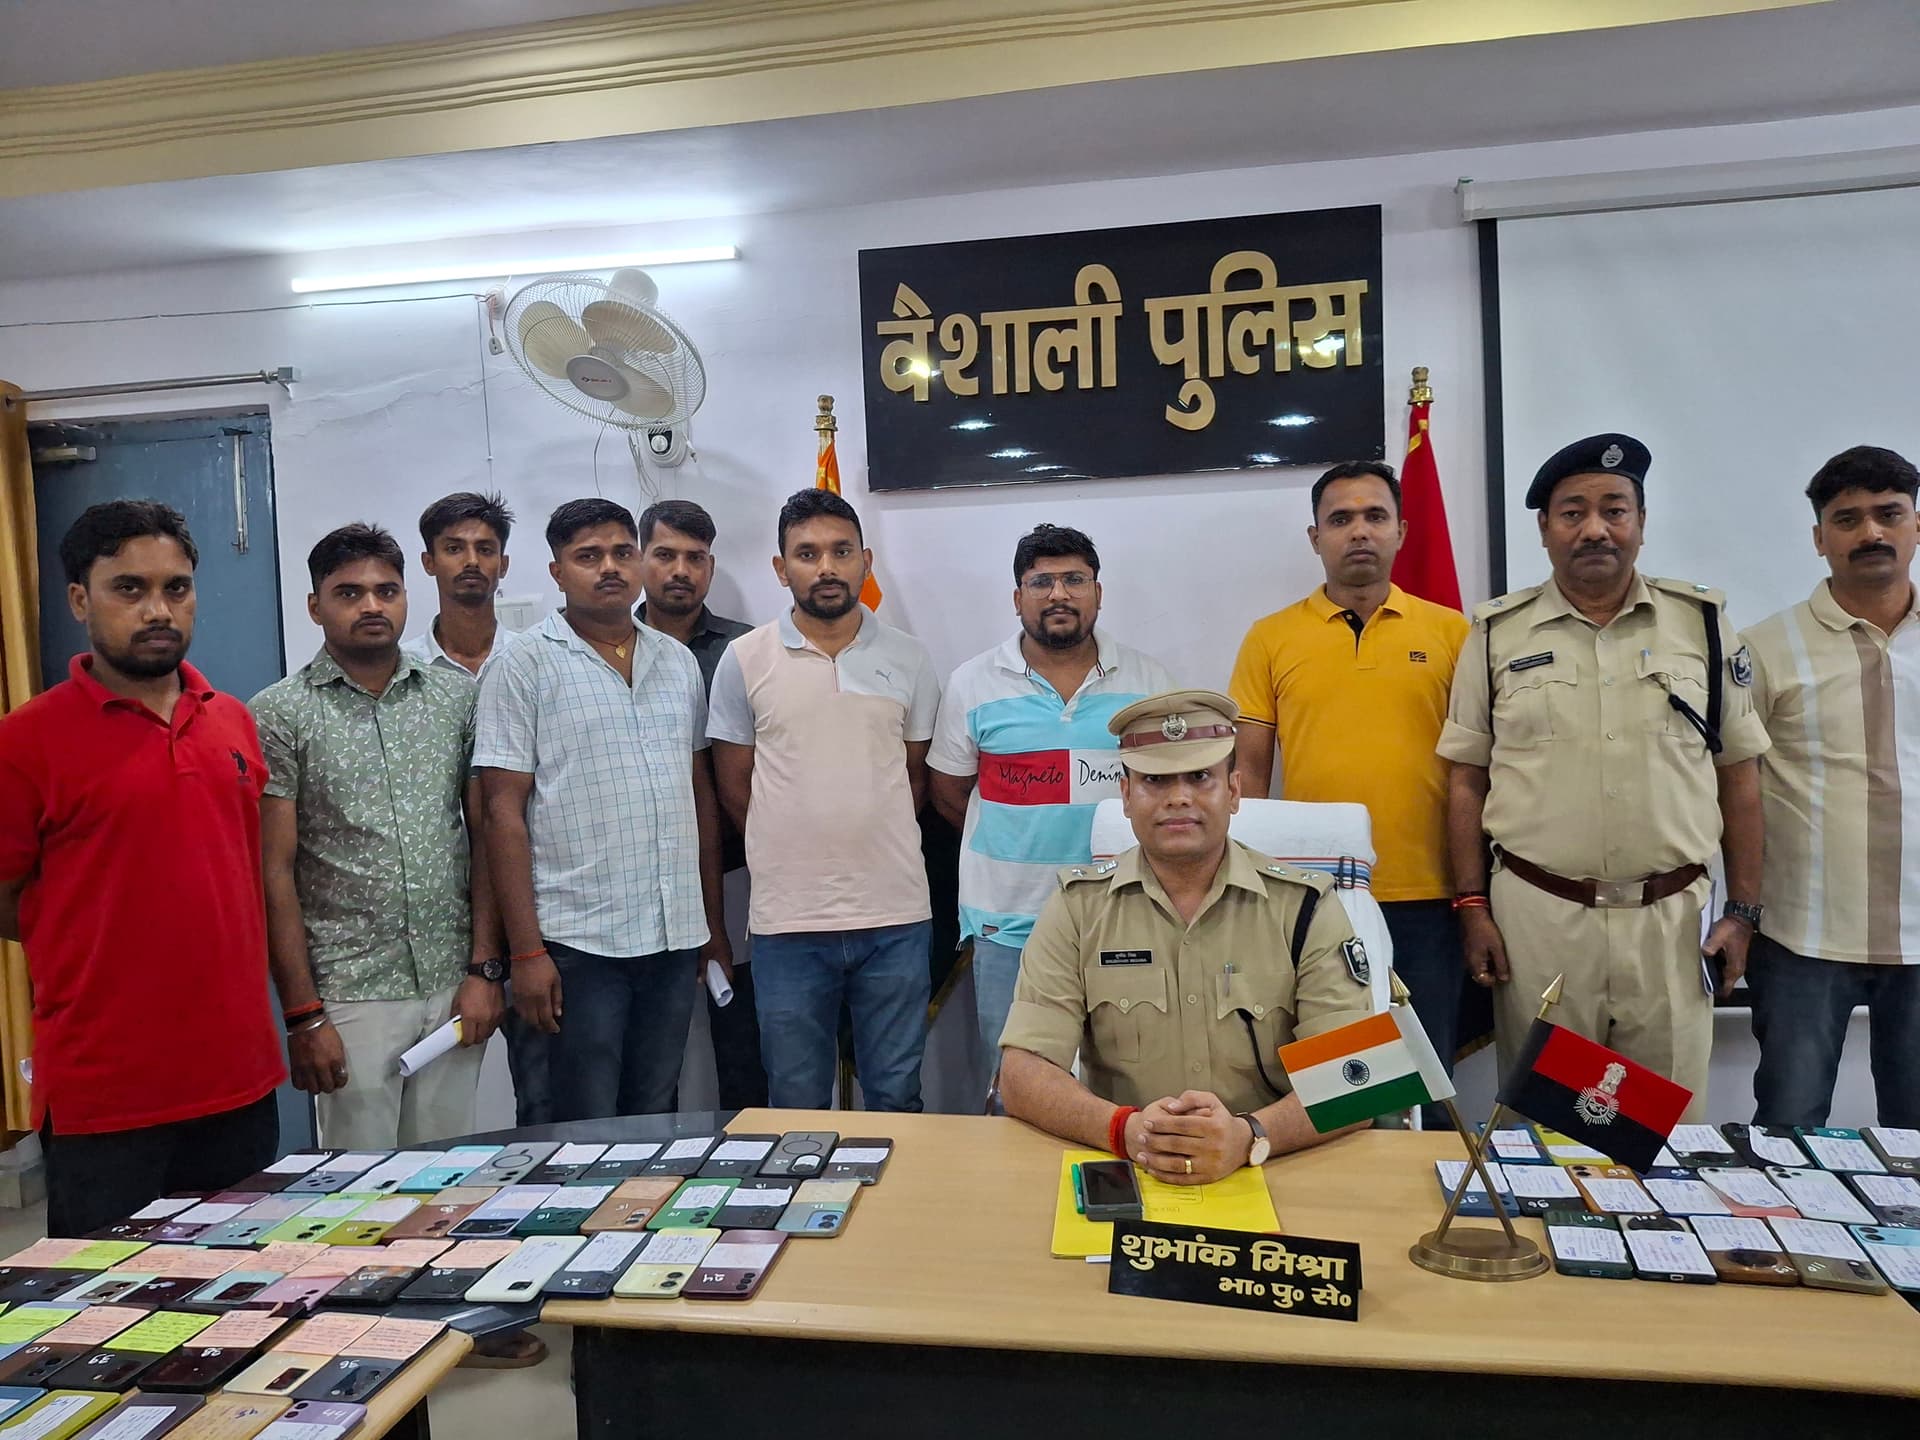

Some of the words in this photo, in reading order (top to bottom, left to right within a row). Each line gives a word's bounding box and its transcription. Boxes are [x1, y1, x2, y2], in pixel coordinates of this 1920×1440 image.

[877, 263, 1123, 403] वैशाली
[1143, 250, 1369, 431] पुलिस
[1000, 765, 1064, 794] Magneto
[1120, 1234, 1240, 1271] शुभांक
[1250, 1240, 1348, 1281] मिश्रा
[702, 1273, 725, 1283] 24
